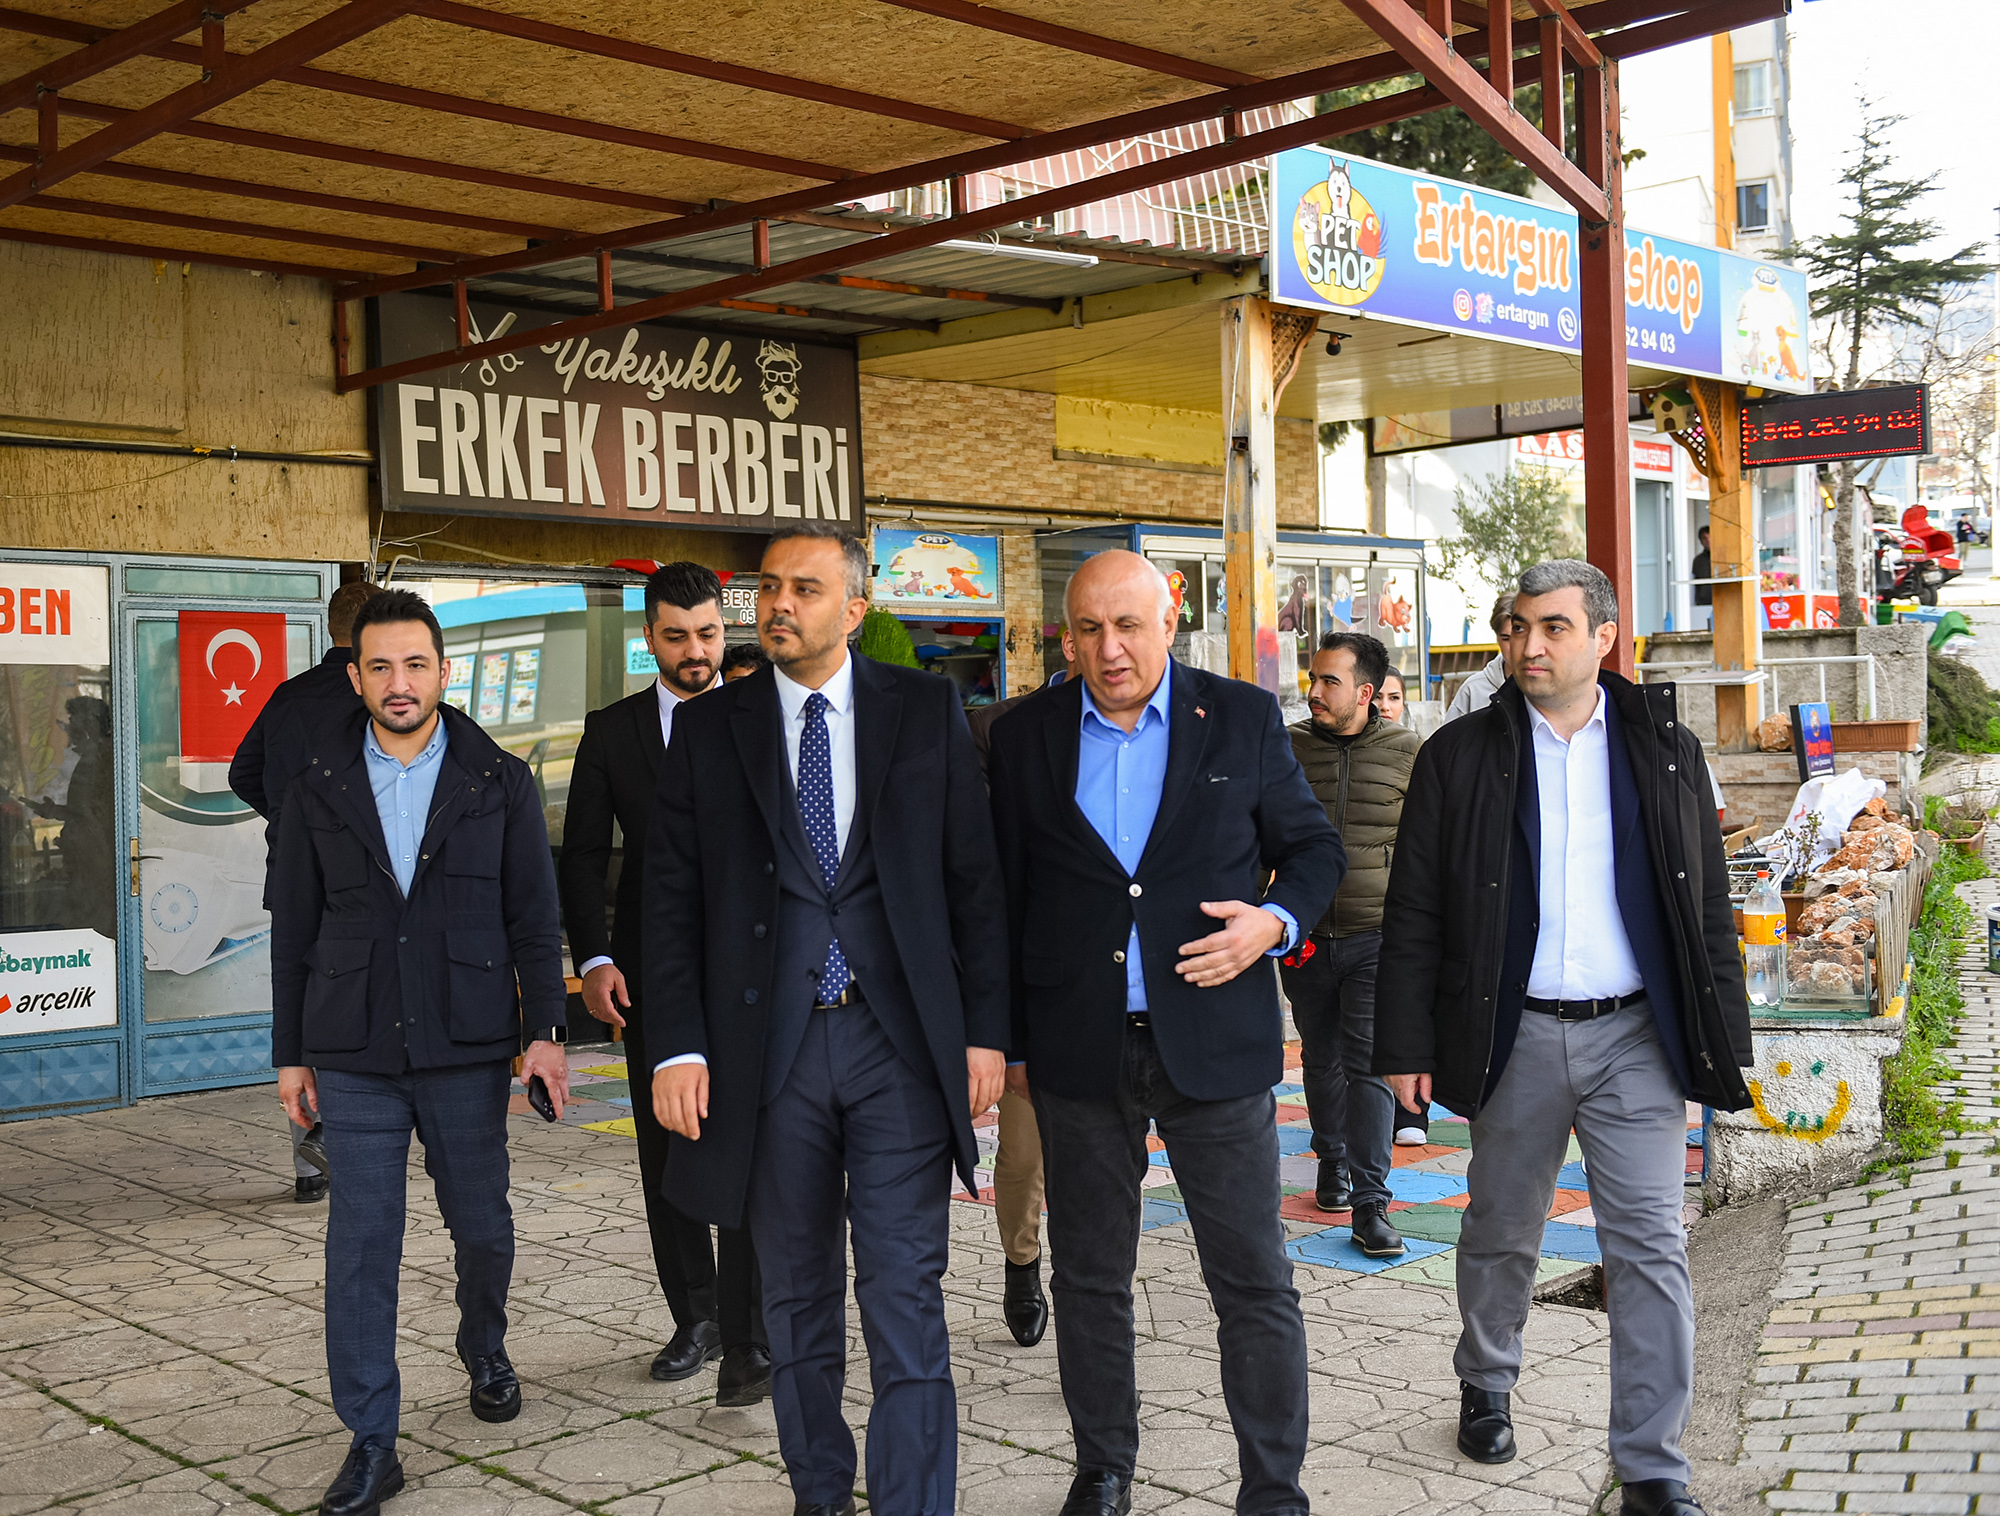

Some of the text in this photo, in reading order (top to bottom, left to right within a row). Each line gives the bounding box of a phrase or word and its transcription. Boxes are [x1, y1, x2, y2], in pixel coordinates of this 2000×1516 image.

[1321, 213, 1361, 252] PET
[1307, 245, 1376, 292] SHOP
[1623, 236, 1702, 333] shop
[1641, 328, 1657, 351] 94
[1660, 332, 1676, 354] 03
[540, 328, 742, 401] Yakışıklı
[398, 383, 607, 506] ERKEK
[925, 536, 944, 544] PET
[740, 609, 758, 625] 05
[6, 948, 92, 975] baymak
[16, 986, 96, 1016] arçelik
